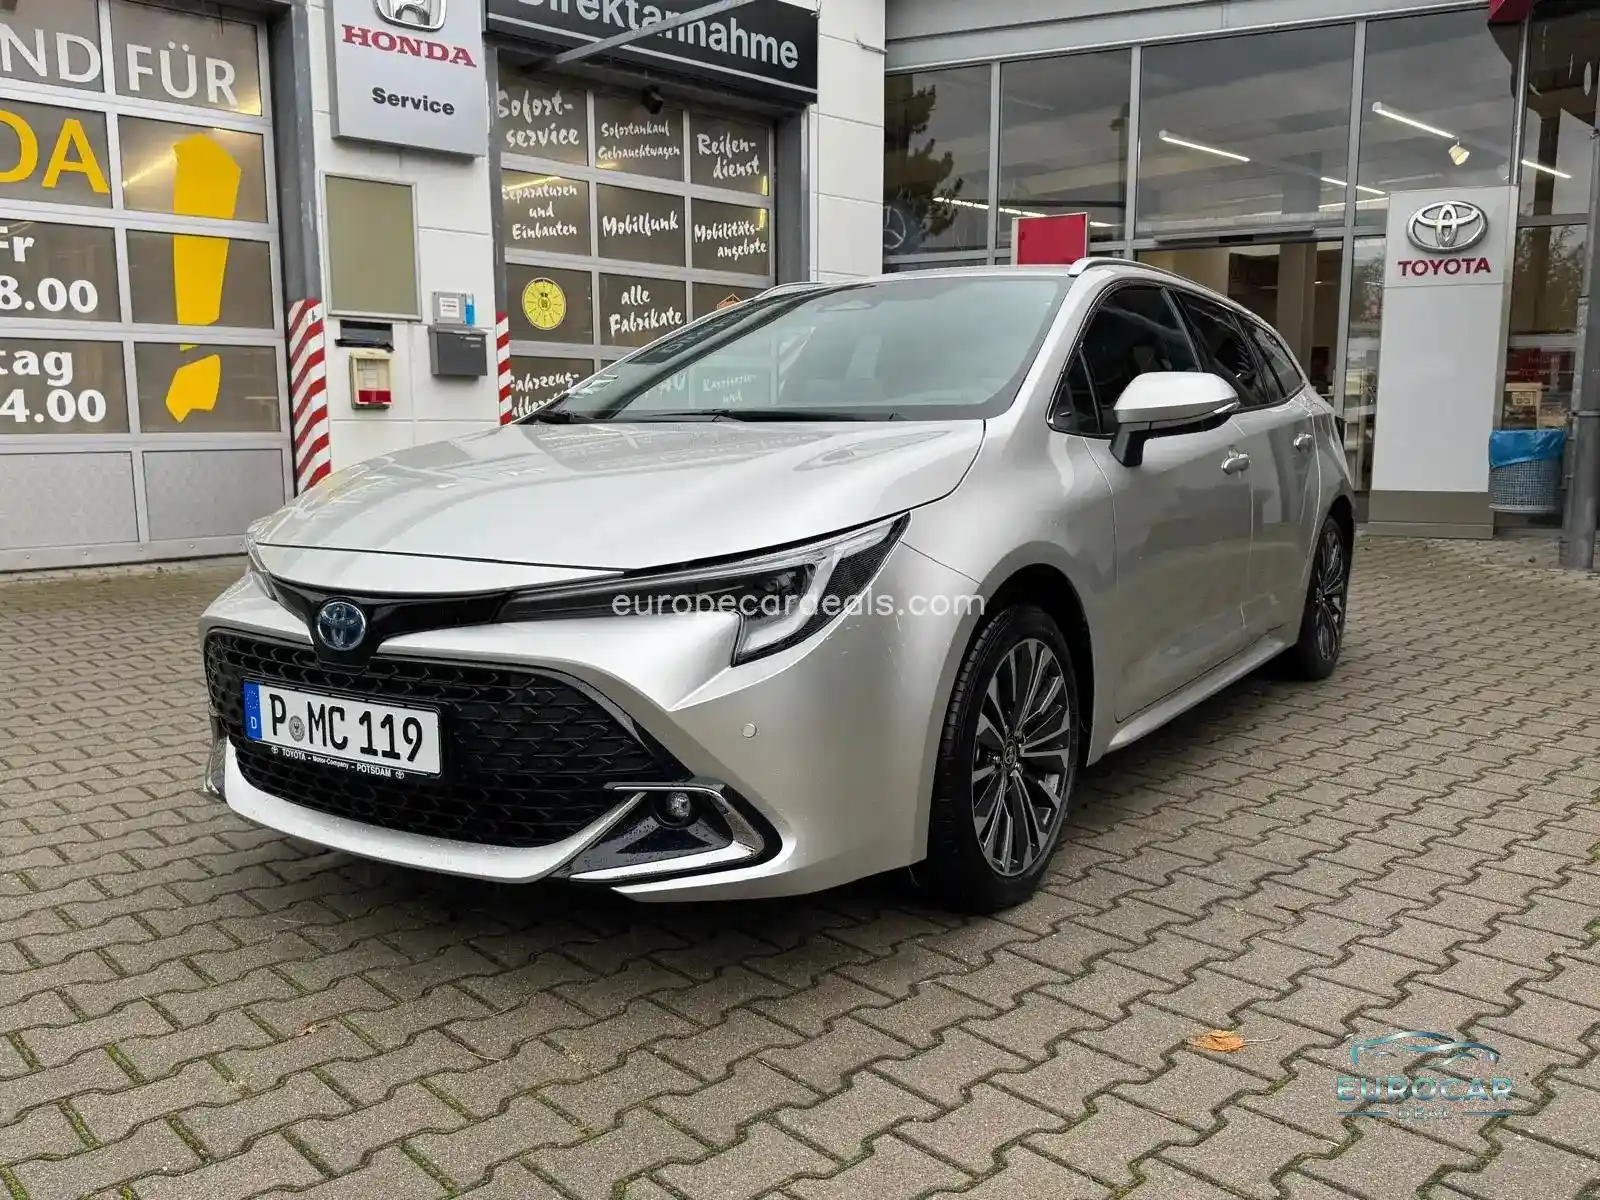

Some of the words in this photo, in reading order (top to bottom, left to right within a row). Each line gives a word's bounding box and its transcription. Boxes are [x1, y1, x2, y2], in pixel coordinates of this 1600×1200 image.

[341, 24, 477, 68] HONDA
[518, 0, 800, 69] ektannahme
[126, 40, 237, 106] FÜR
[372, 86, 456, 116] Service
[497, 88, 574, 123] Sofort-
[505, 122, 580, 148] service
[601, 120, 671, 139] Sofortankauf
[598, 144, 681, 161] Gebrauchtwagen
[697, 131, 757, 158] Reifen-
[713, 154, 760, 180] dienst
[528, 201, 555, 218] und
[512, 221, 578, 240] Einbauten
[602, 210, 679, 238] Mobilfunk
[717, 237, 768, 261] angebote
[1398, 257, 1492, 277] TOYOTA
[621, 284, 651, 306] alle
[609, 306, 683, 337] Fabrikate
[250, 716, 258, 729] D
[269, 693, 287, 736] P
[307, 701, 349, 751] MC
[358, 710, 423, 762] 119
[281, 748, 306, 761] TOYOTA
[356, 763, 392, 778] POTSDAM
